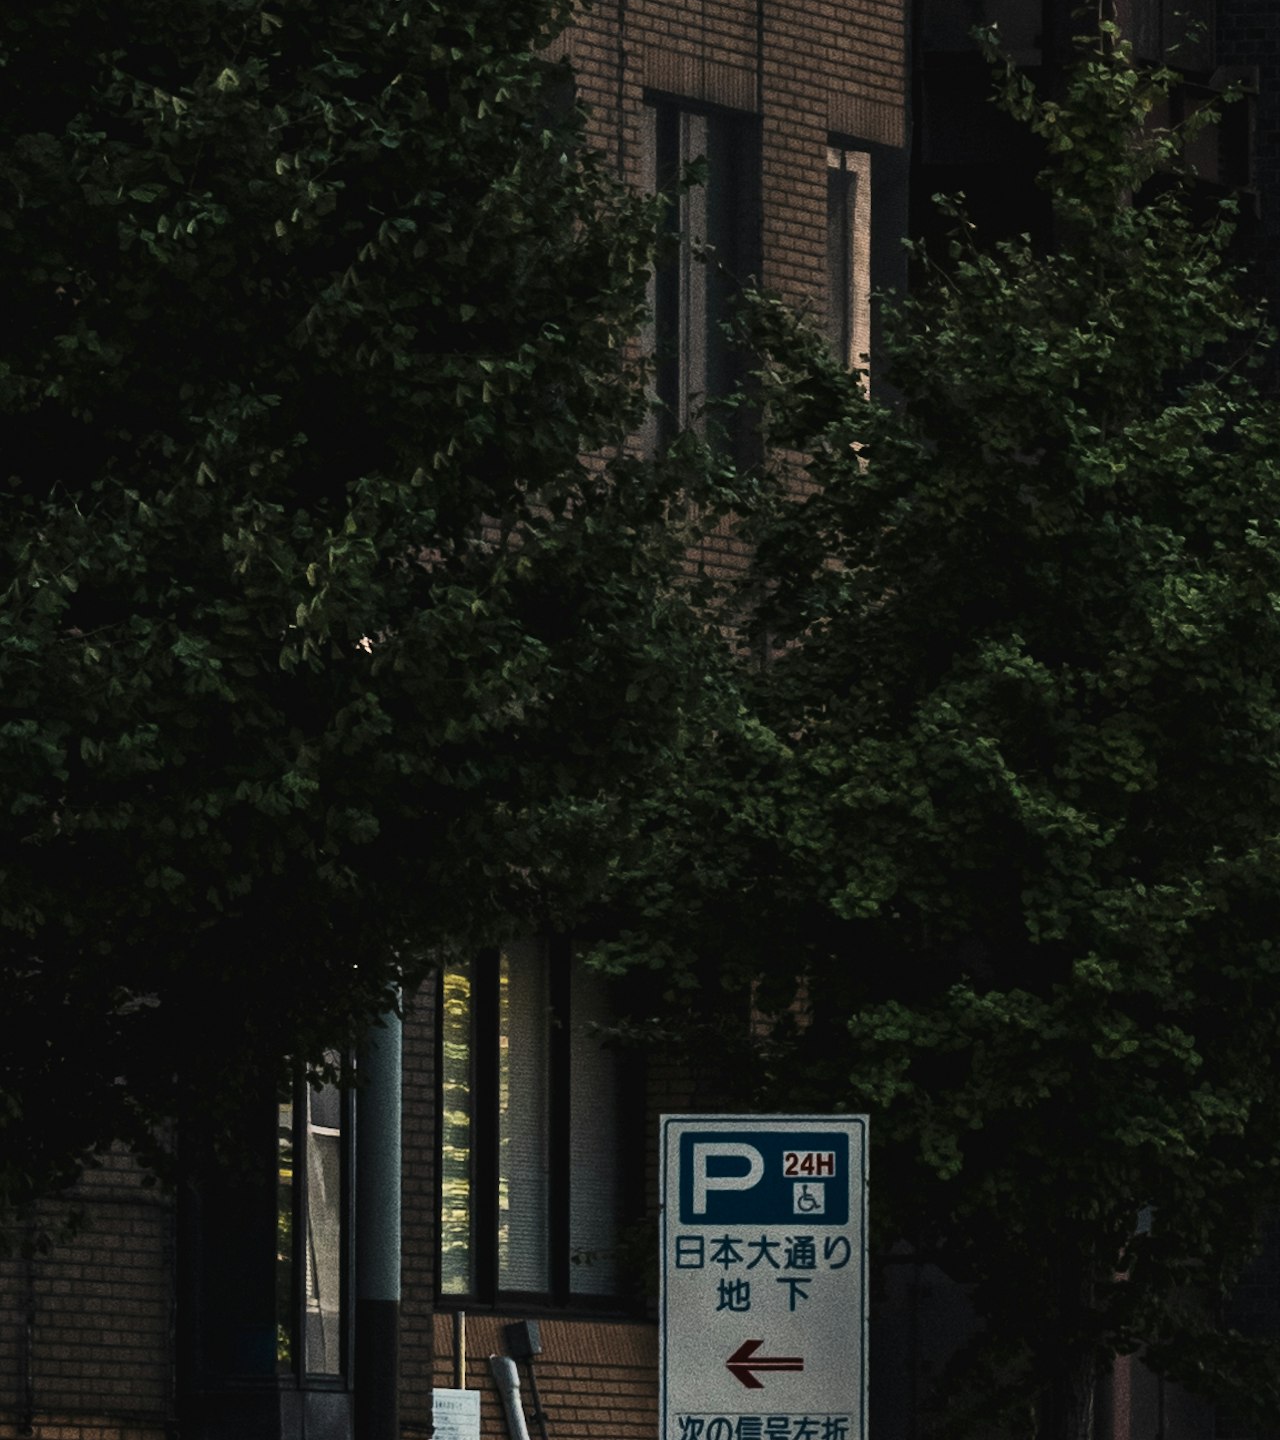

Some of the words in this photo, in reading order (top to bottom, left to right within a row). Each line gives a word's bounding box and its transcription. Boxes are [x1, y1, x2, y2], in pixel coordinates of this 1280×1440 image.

[692, 1142, 765, 1214] P
[784, 1152, 834, 1176] 24H
[675, 1233, 852, 1271] 日本大通り
[716, 1277, 750, 1312] 地
[776, 1277, 813, 1312] 下
